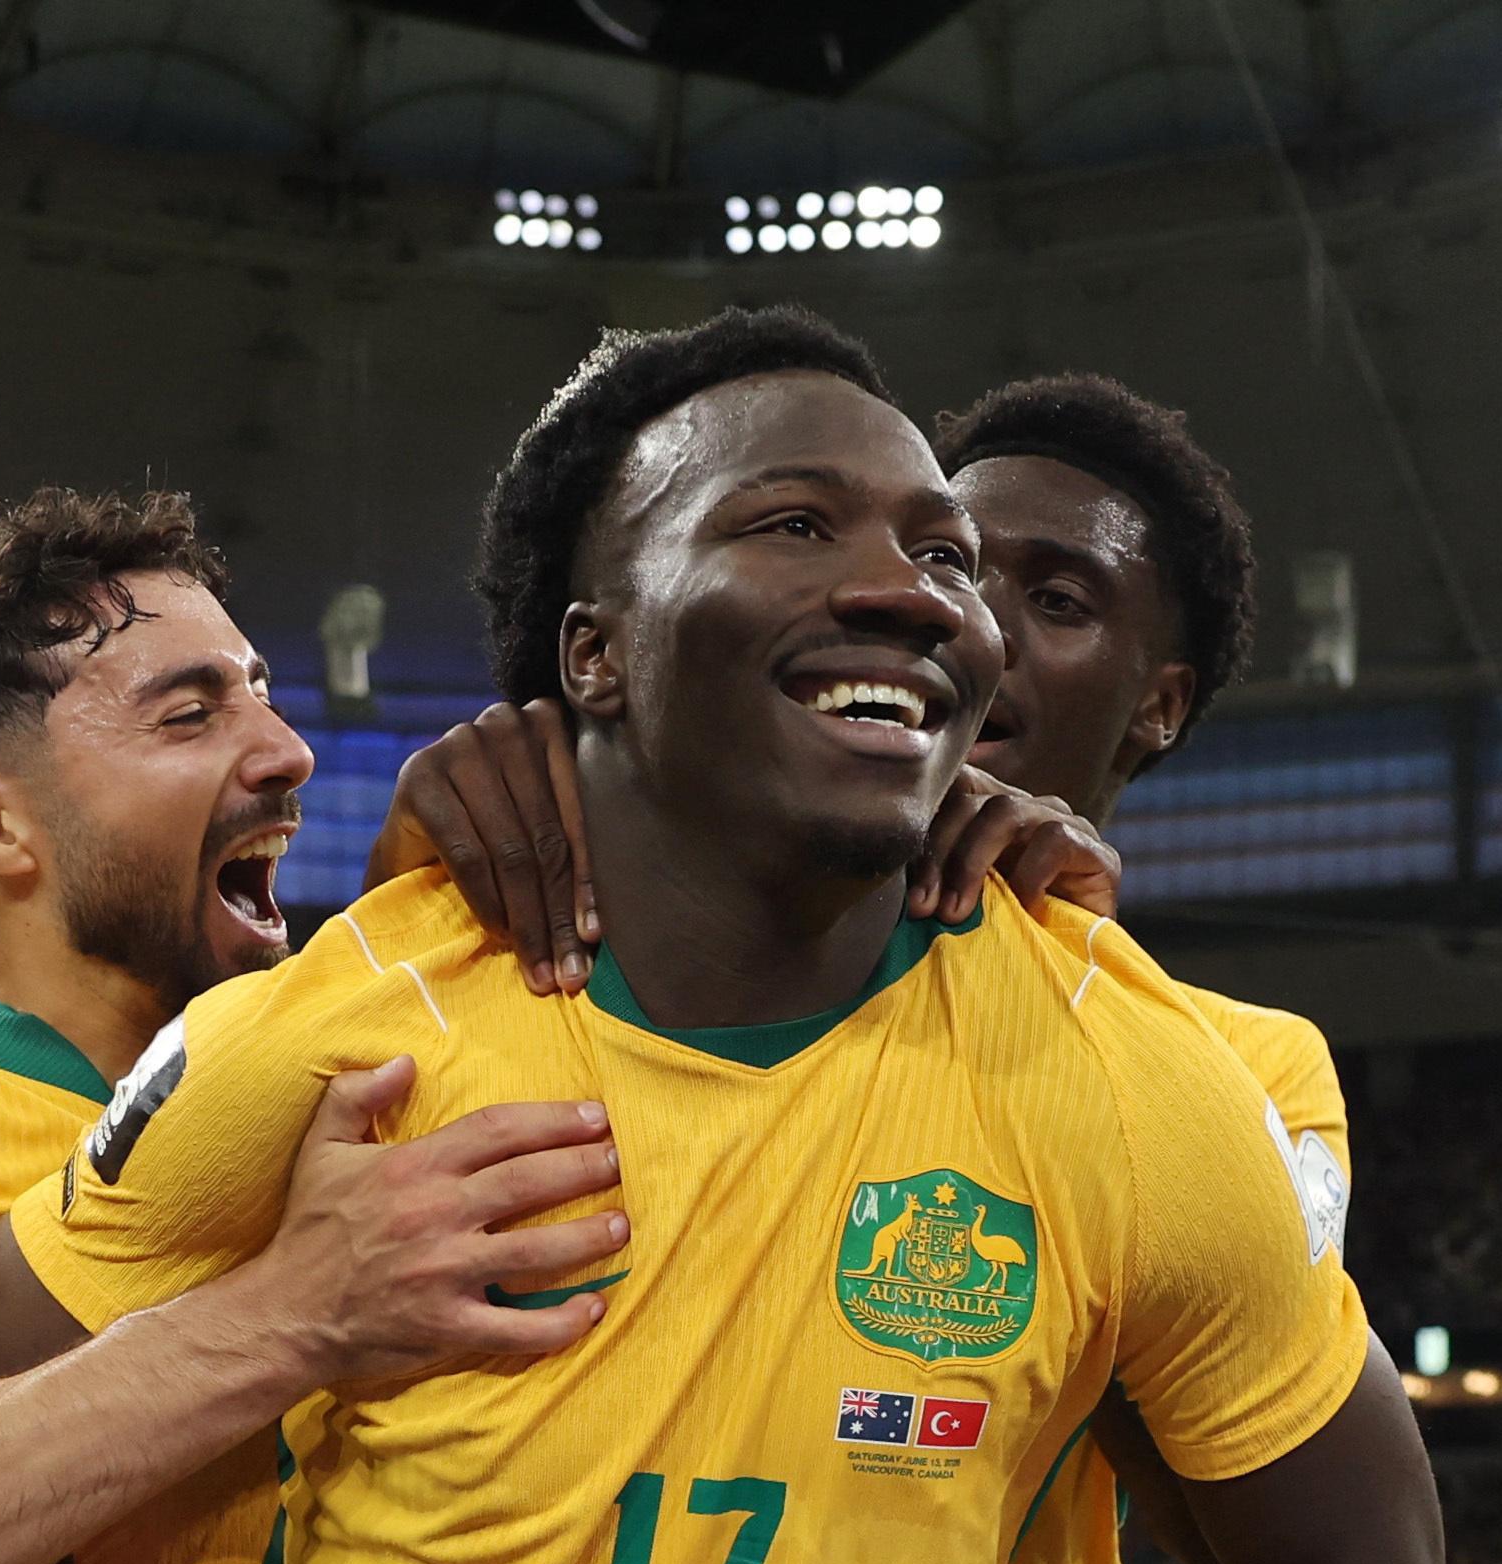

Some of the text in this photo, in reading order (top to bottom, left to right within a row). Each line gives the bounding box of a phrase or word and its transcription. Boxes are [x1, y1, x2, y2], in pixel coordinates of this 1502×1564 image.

[865, 1281, 1001, 1318] AUSTRALIA
[847, 1451, 902, 1464] SATURDAY
[903, 1457, 929, 1467] JUNE
[917, 1469, 954, 1479] CANADA
